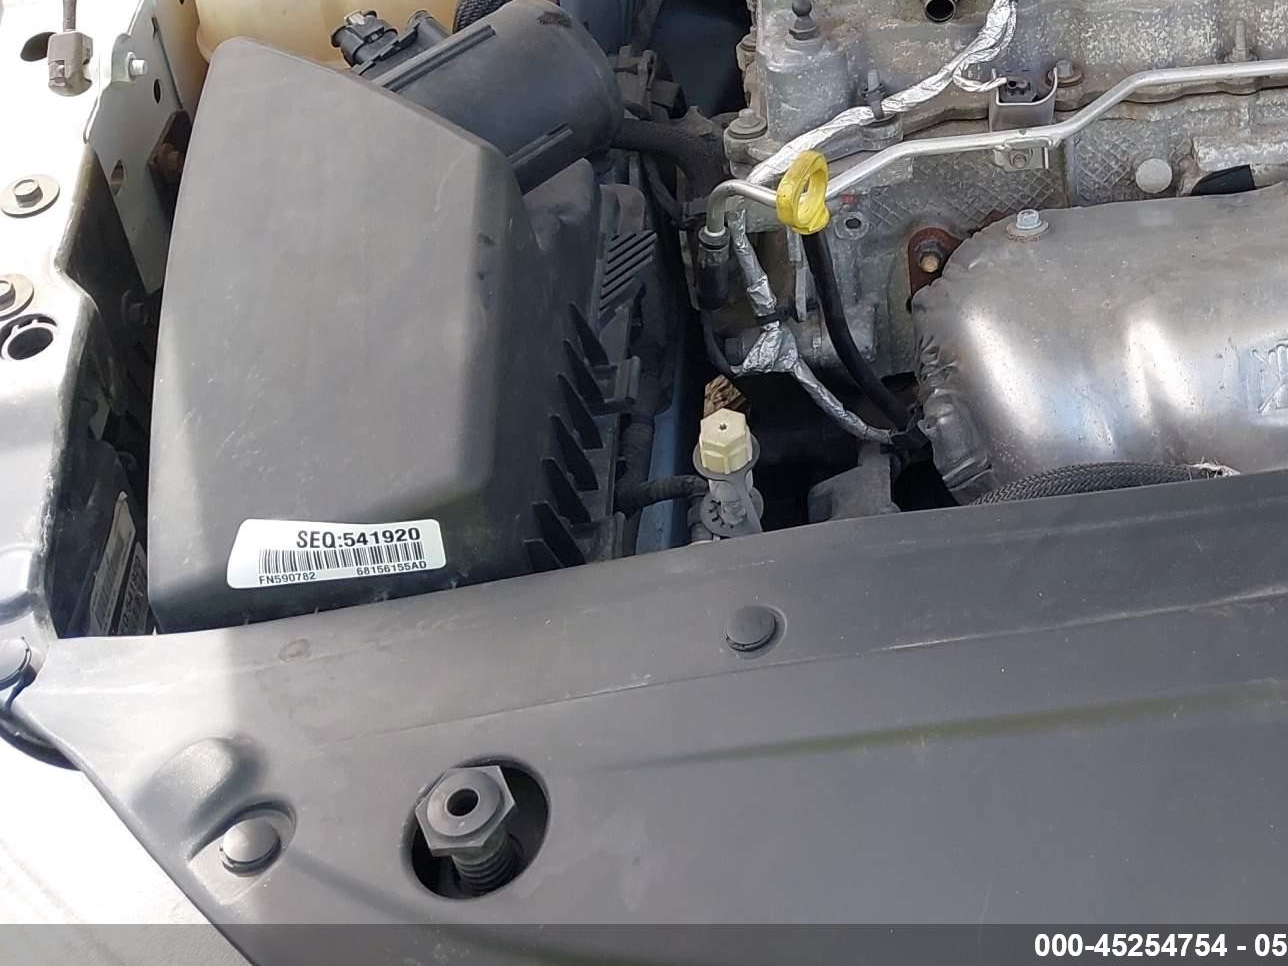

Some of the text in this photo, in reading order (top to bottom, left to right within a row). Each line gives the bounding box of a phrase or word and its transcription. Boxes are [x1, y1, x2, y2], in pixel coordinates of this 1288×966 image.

[296, 527, 422, 549] SEQ:541920
[356, 560, 427, 576] 68156155AD
[258, 571, 317, 585] FN590782
